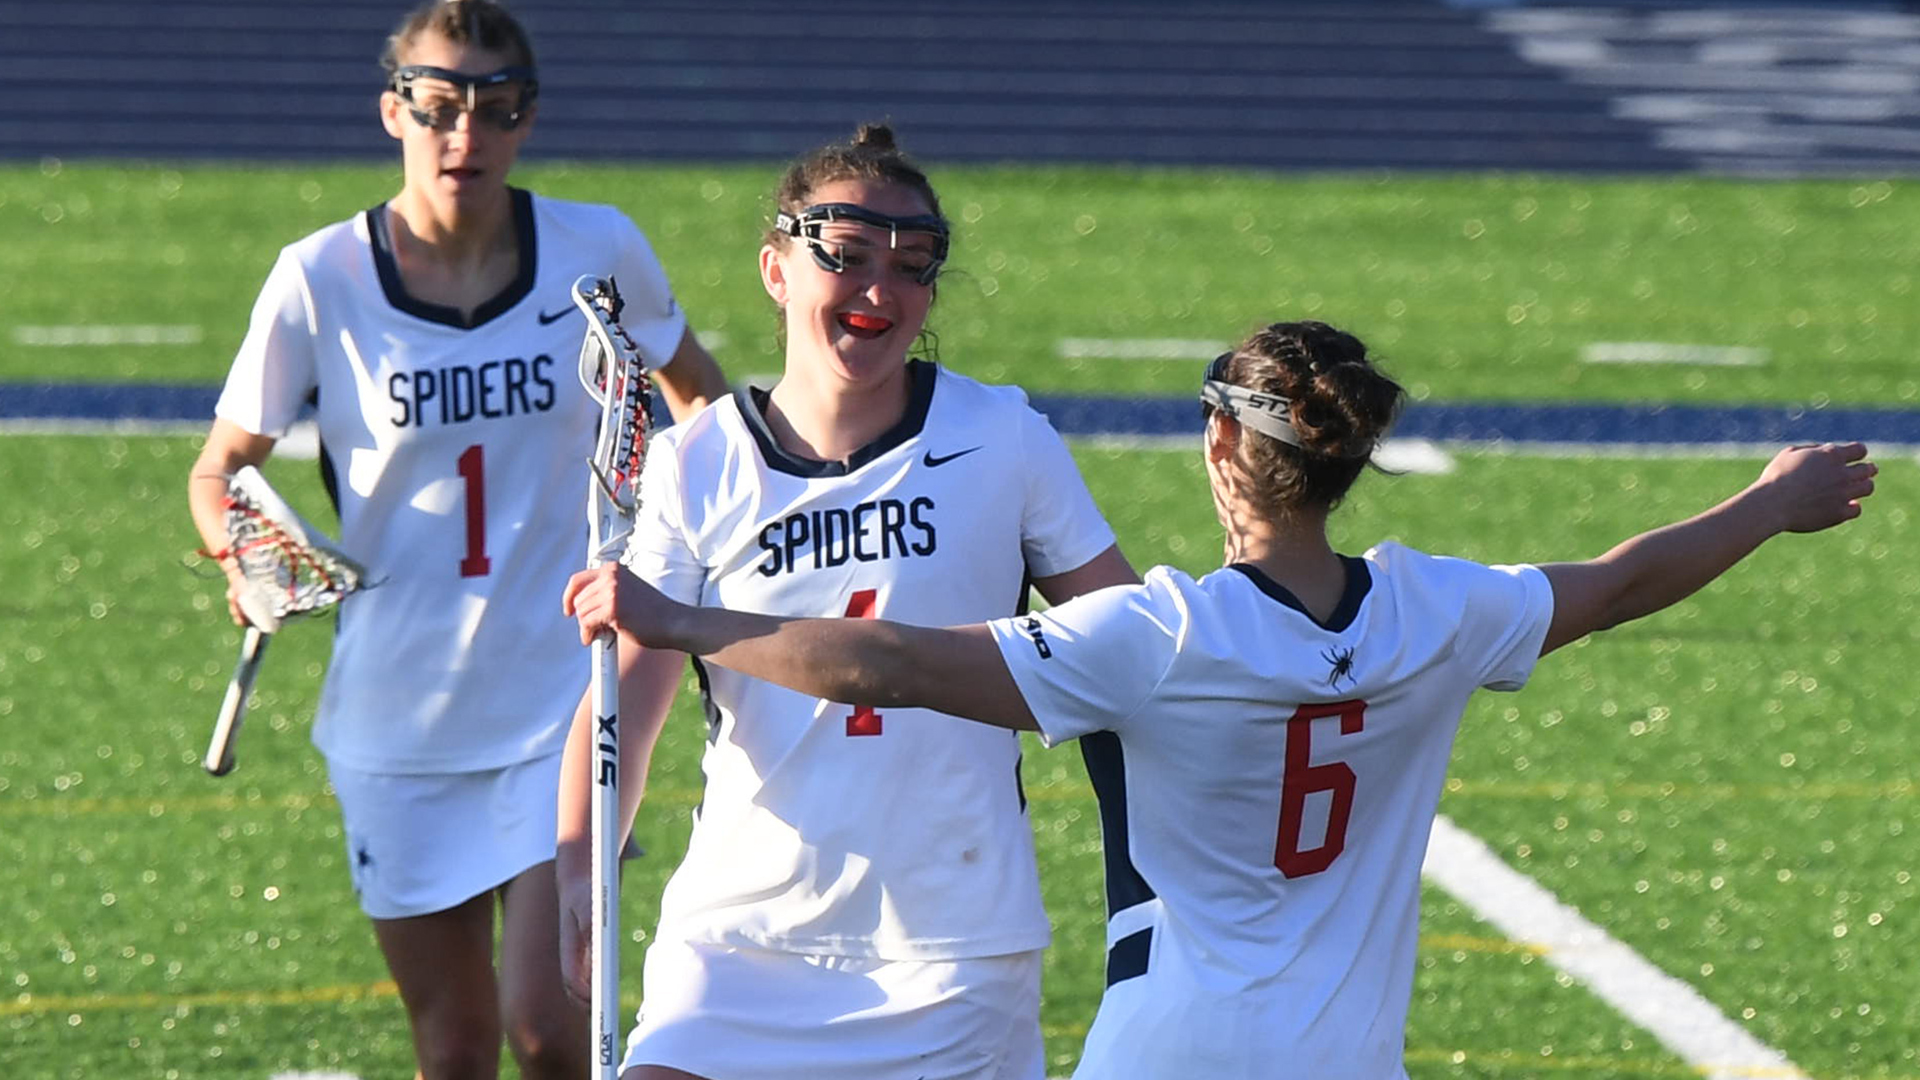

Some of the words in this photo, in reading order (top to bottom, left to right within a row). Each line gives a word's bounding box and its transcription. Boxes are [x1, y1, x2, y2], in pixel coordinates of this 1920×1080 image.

[389, 354, 556, 428] SPIDERS
[457, 444, 491, 578] 1
[758, 497, 936, 578] SPIDERS
[1274, 699, 1368, 879] 6
